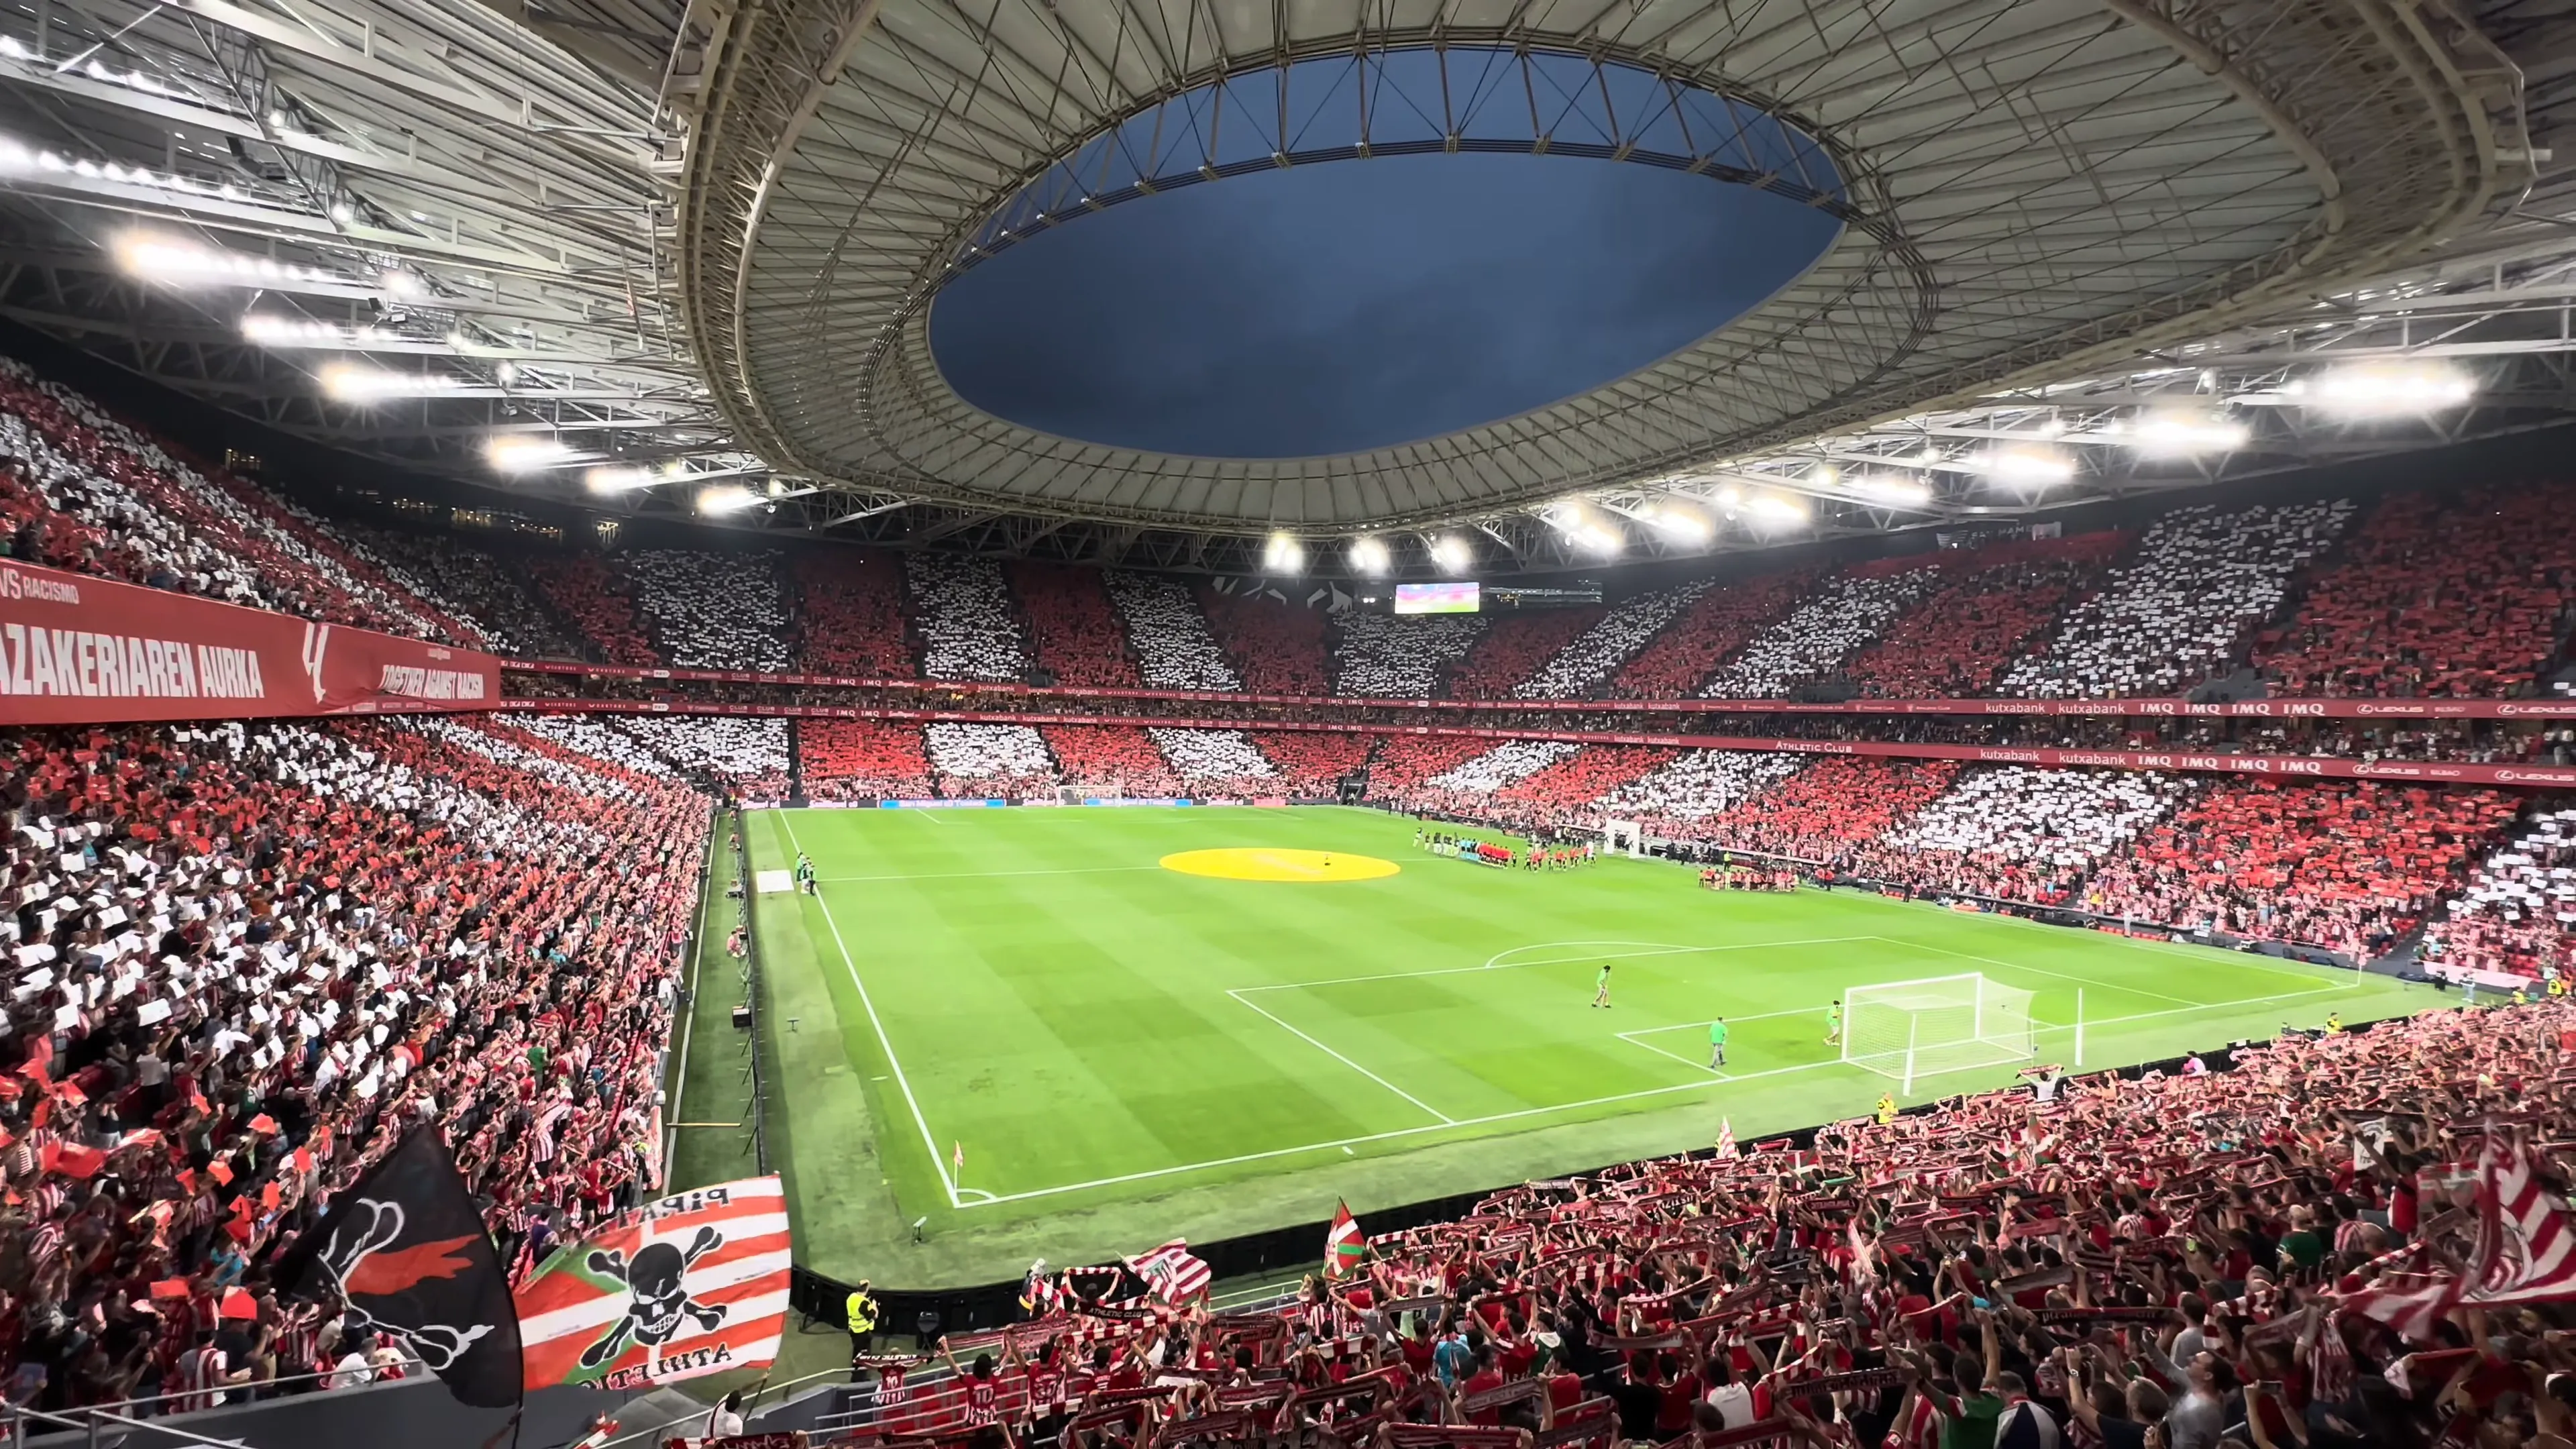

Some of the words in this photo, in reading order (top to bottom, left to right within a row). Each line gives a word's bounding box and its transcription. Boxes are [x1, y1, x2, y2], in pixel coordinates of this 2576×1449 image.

[23, 576, 79, 604] RACISMO
[198, 645, 264, 698] AURKA
[423, 669, 457, 699] AGAINST
[1986, 702, 2045, 714] kutxabank
[2058, 703, 2125, 714] kutxabank
[2140, 703, 2175, 714] IMQ
[2185, 704, 2220, 714] IMQ
[2232, 704, 2271, 715] IMQ
[2284, 703, 2325, 716] IMQ
[979, 713, 1016, 721] kutxabank
[1022, 714, 1057, 722] kutxabank
[1776, 740, 1821, 752] ATHLETIC
[1824, 742, 1852, 753] CLUB
[1980, 749, 2039, 761] kutxabank
[2059, 752, 2126, 765] kutxabank
[2138, 755, 2172, 767] IMQ
[2182, 757, 2219, 769] IMQ
[2231, 759, 2269, 771] IMQ
[2280, 761, 2322, 774] IMQ
[2370, 767, 2420, 775] LEXUS
[2516, 773, 2575, 782] LEXUS
[1089, 1307, 1122, 1318] ATHLETIC
[1124, 1309, 1142, 1318] CLUB
[885, 1375, 898, 1389] 10
[973, 1387, 994, 1404] 10
